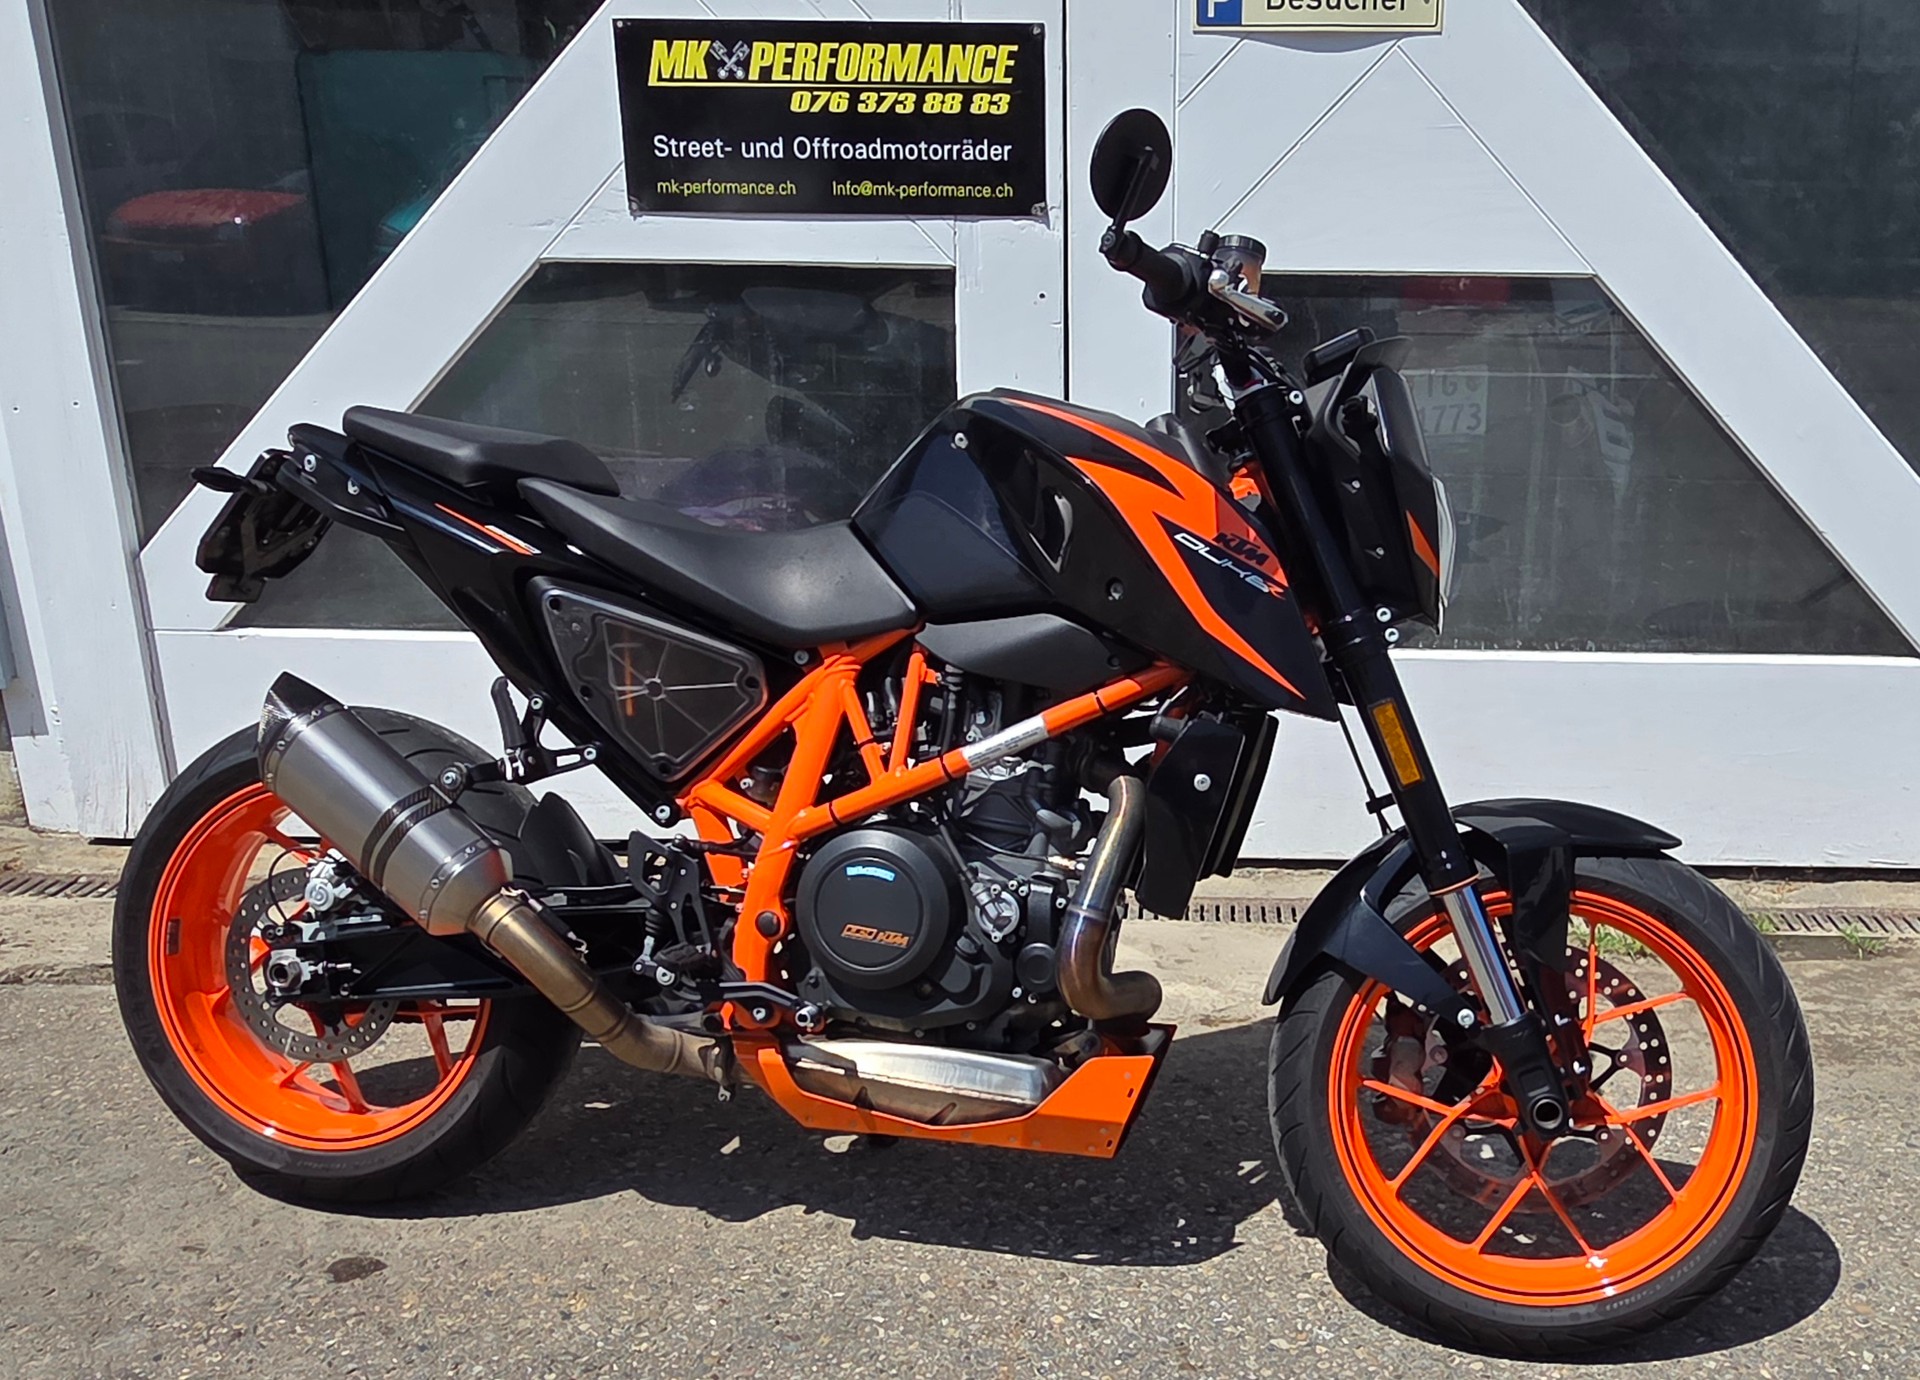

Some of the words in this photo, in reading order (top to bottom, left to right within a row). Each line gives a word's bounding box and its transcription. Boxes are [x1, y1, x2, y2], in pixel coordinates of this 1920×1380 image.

[648, 40, 711, 86] MK
[749, 41, 1018, 84] PERFORMANCE
[790, 91, 850, 113] 076
[857, 92, 916, 114] 373
[922, 93, 963, 114] 88
[969, 93, 1011, 115] 83
[653, 134, 732, 158] Street-
[741, 136, 783, 158] und
[793, 136, 1012, 161] Offroadmotorräder
[657, 178, 796, 197] mk-performance.ch
[832, 180, 1013, 200] Info@mk-performance.ch
[1212, 532, 1269, 566] KTM
